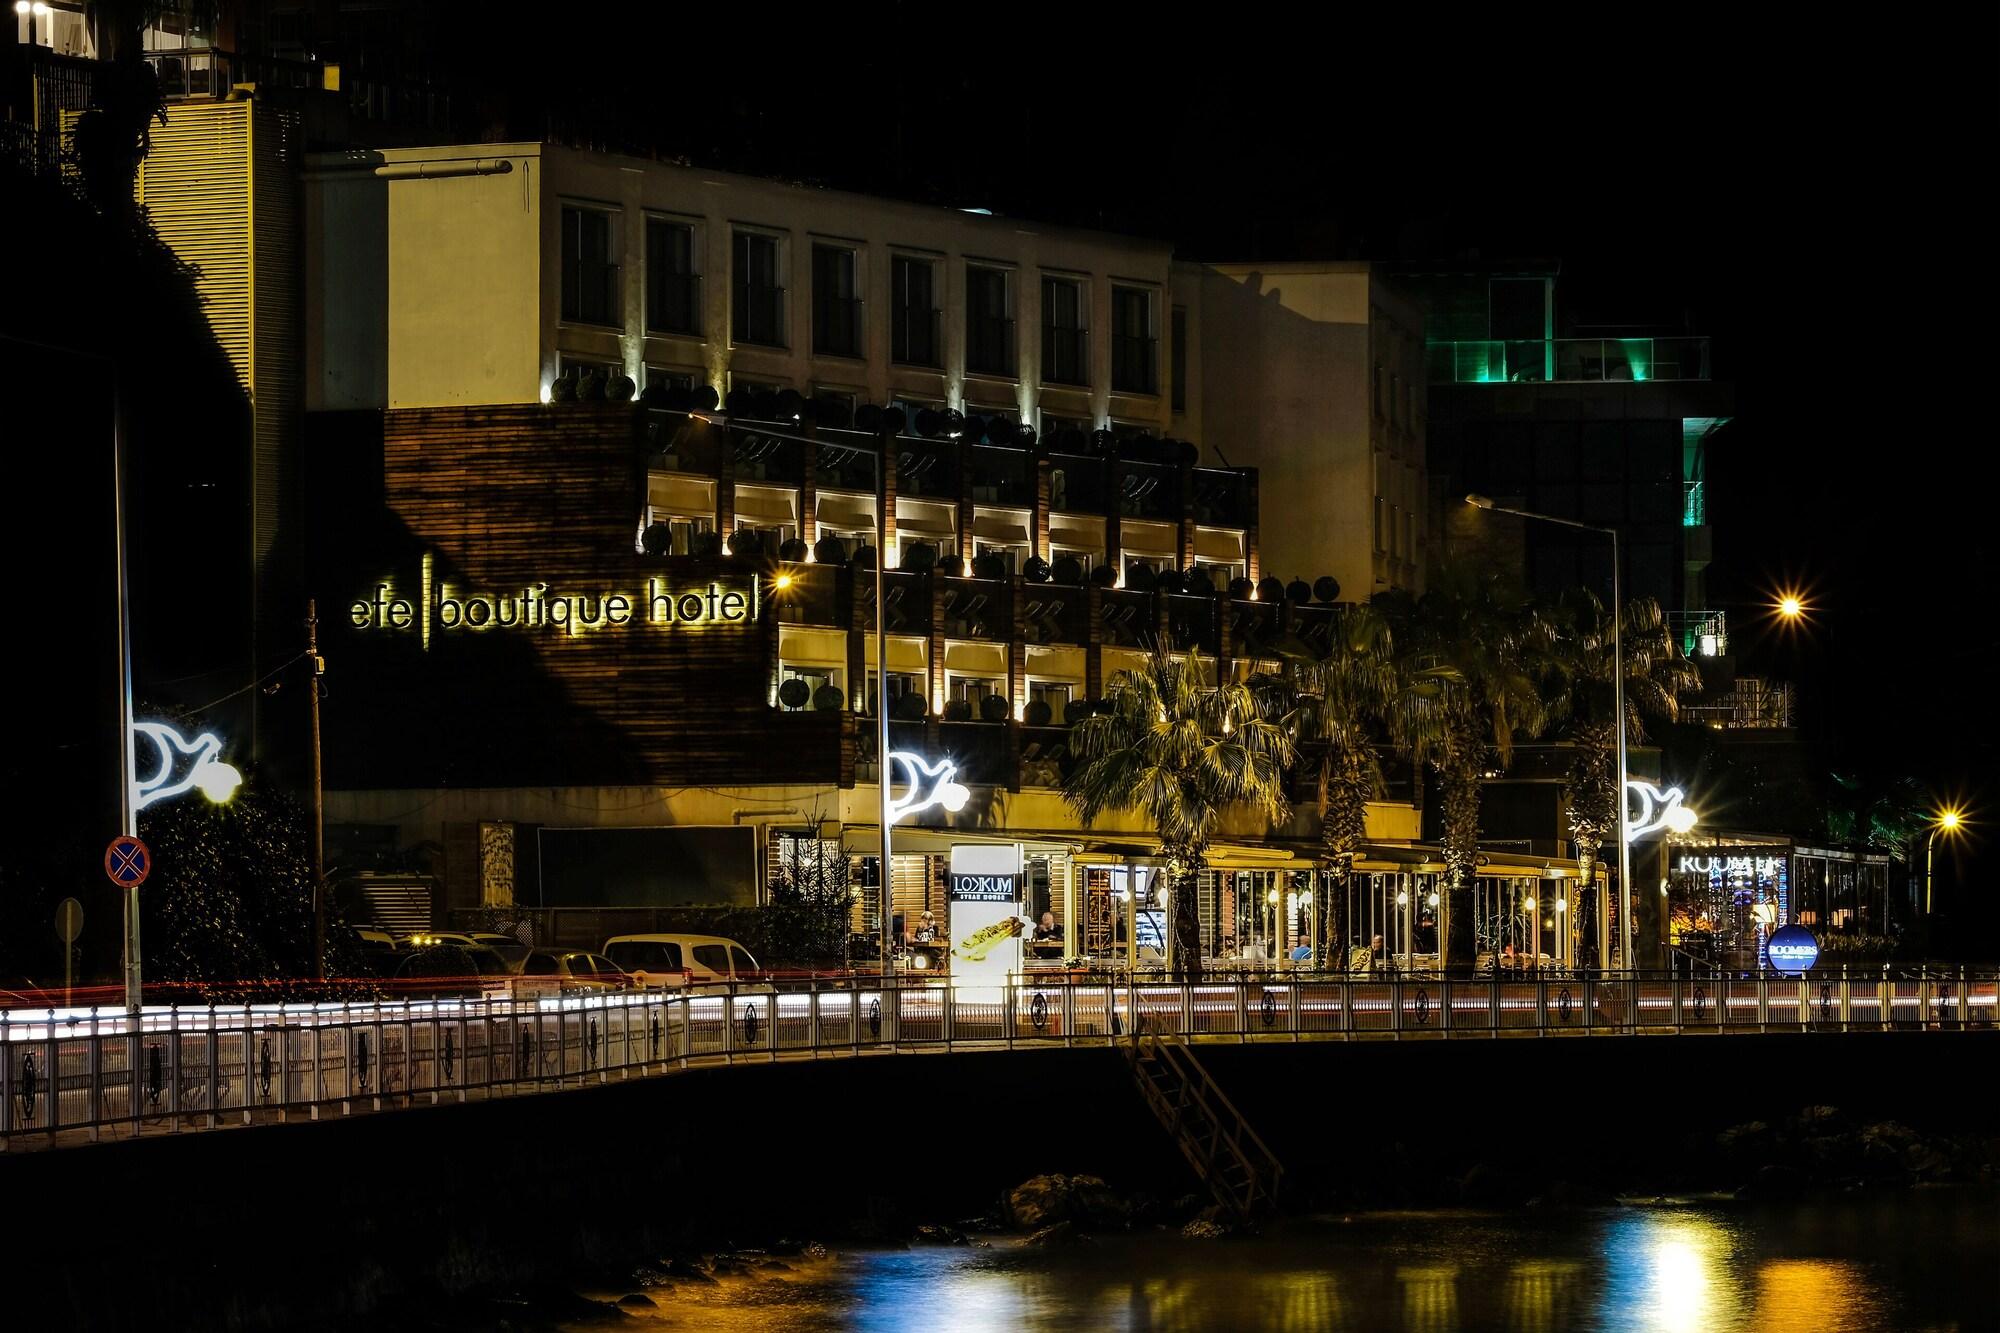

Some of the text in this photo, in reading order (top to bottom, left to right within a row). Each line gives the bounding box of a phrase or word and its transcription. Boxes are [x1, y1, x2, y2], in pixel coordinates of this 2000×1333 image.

[349, 573, 760, 637] efe boutique hotel
